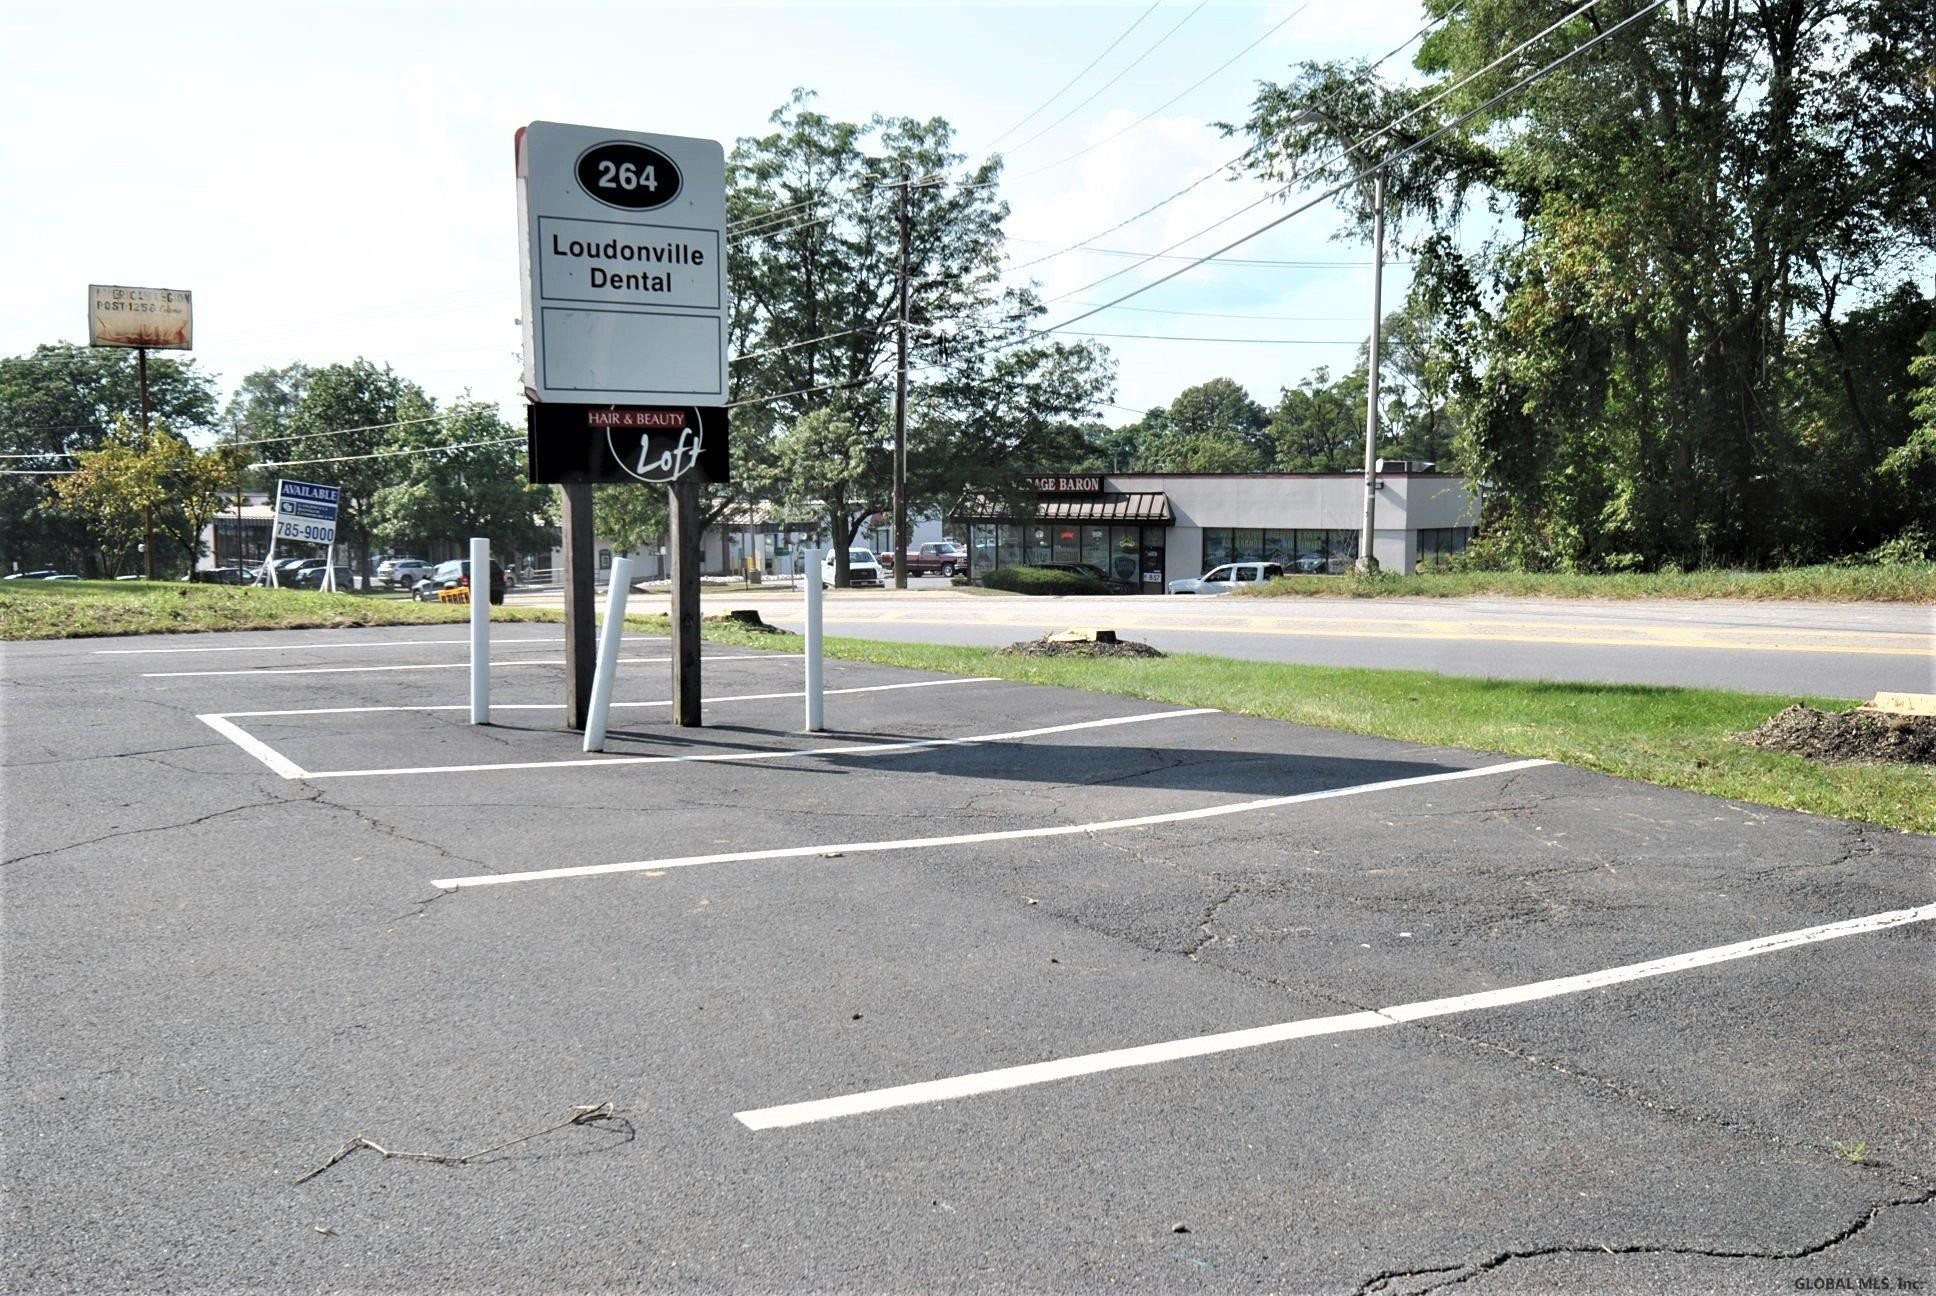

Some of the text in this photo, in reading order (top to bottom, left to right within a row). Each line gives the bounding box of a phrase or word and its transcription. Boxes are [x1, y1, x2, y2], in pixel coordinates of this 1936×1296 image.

[598, 160, 658, 192] 264
[553, 234, 704, 266] Loudonville
[591, 267, 672, 292] Dental
[97, 301, 125, 311] POST
[588, 413, 685, 426] HAIR & BEAUTY
[637, 427, 707, 481] Loft
[282, 484, 337, 501] AVAILABLE
[1059, 477, 1100, 491] BARON
[278, 522, 334, 542] 785-9000
